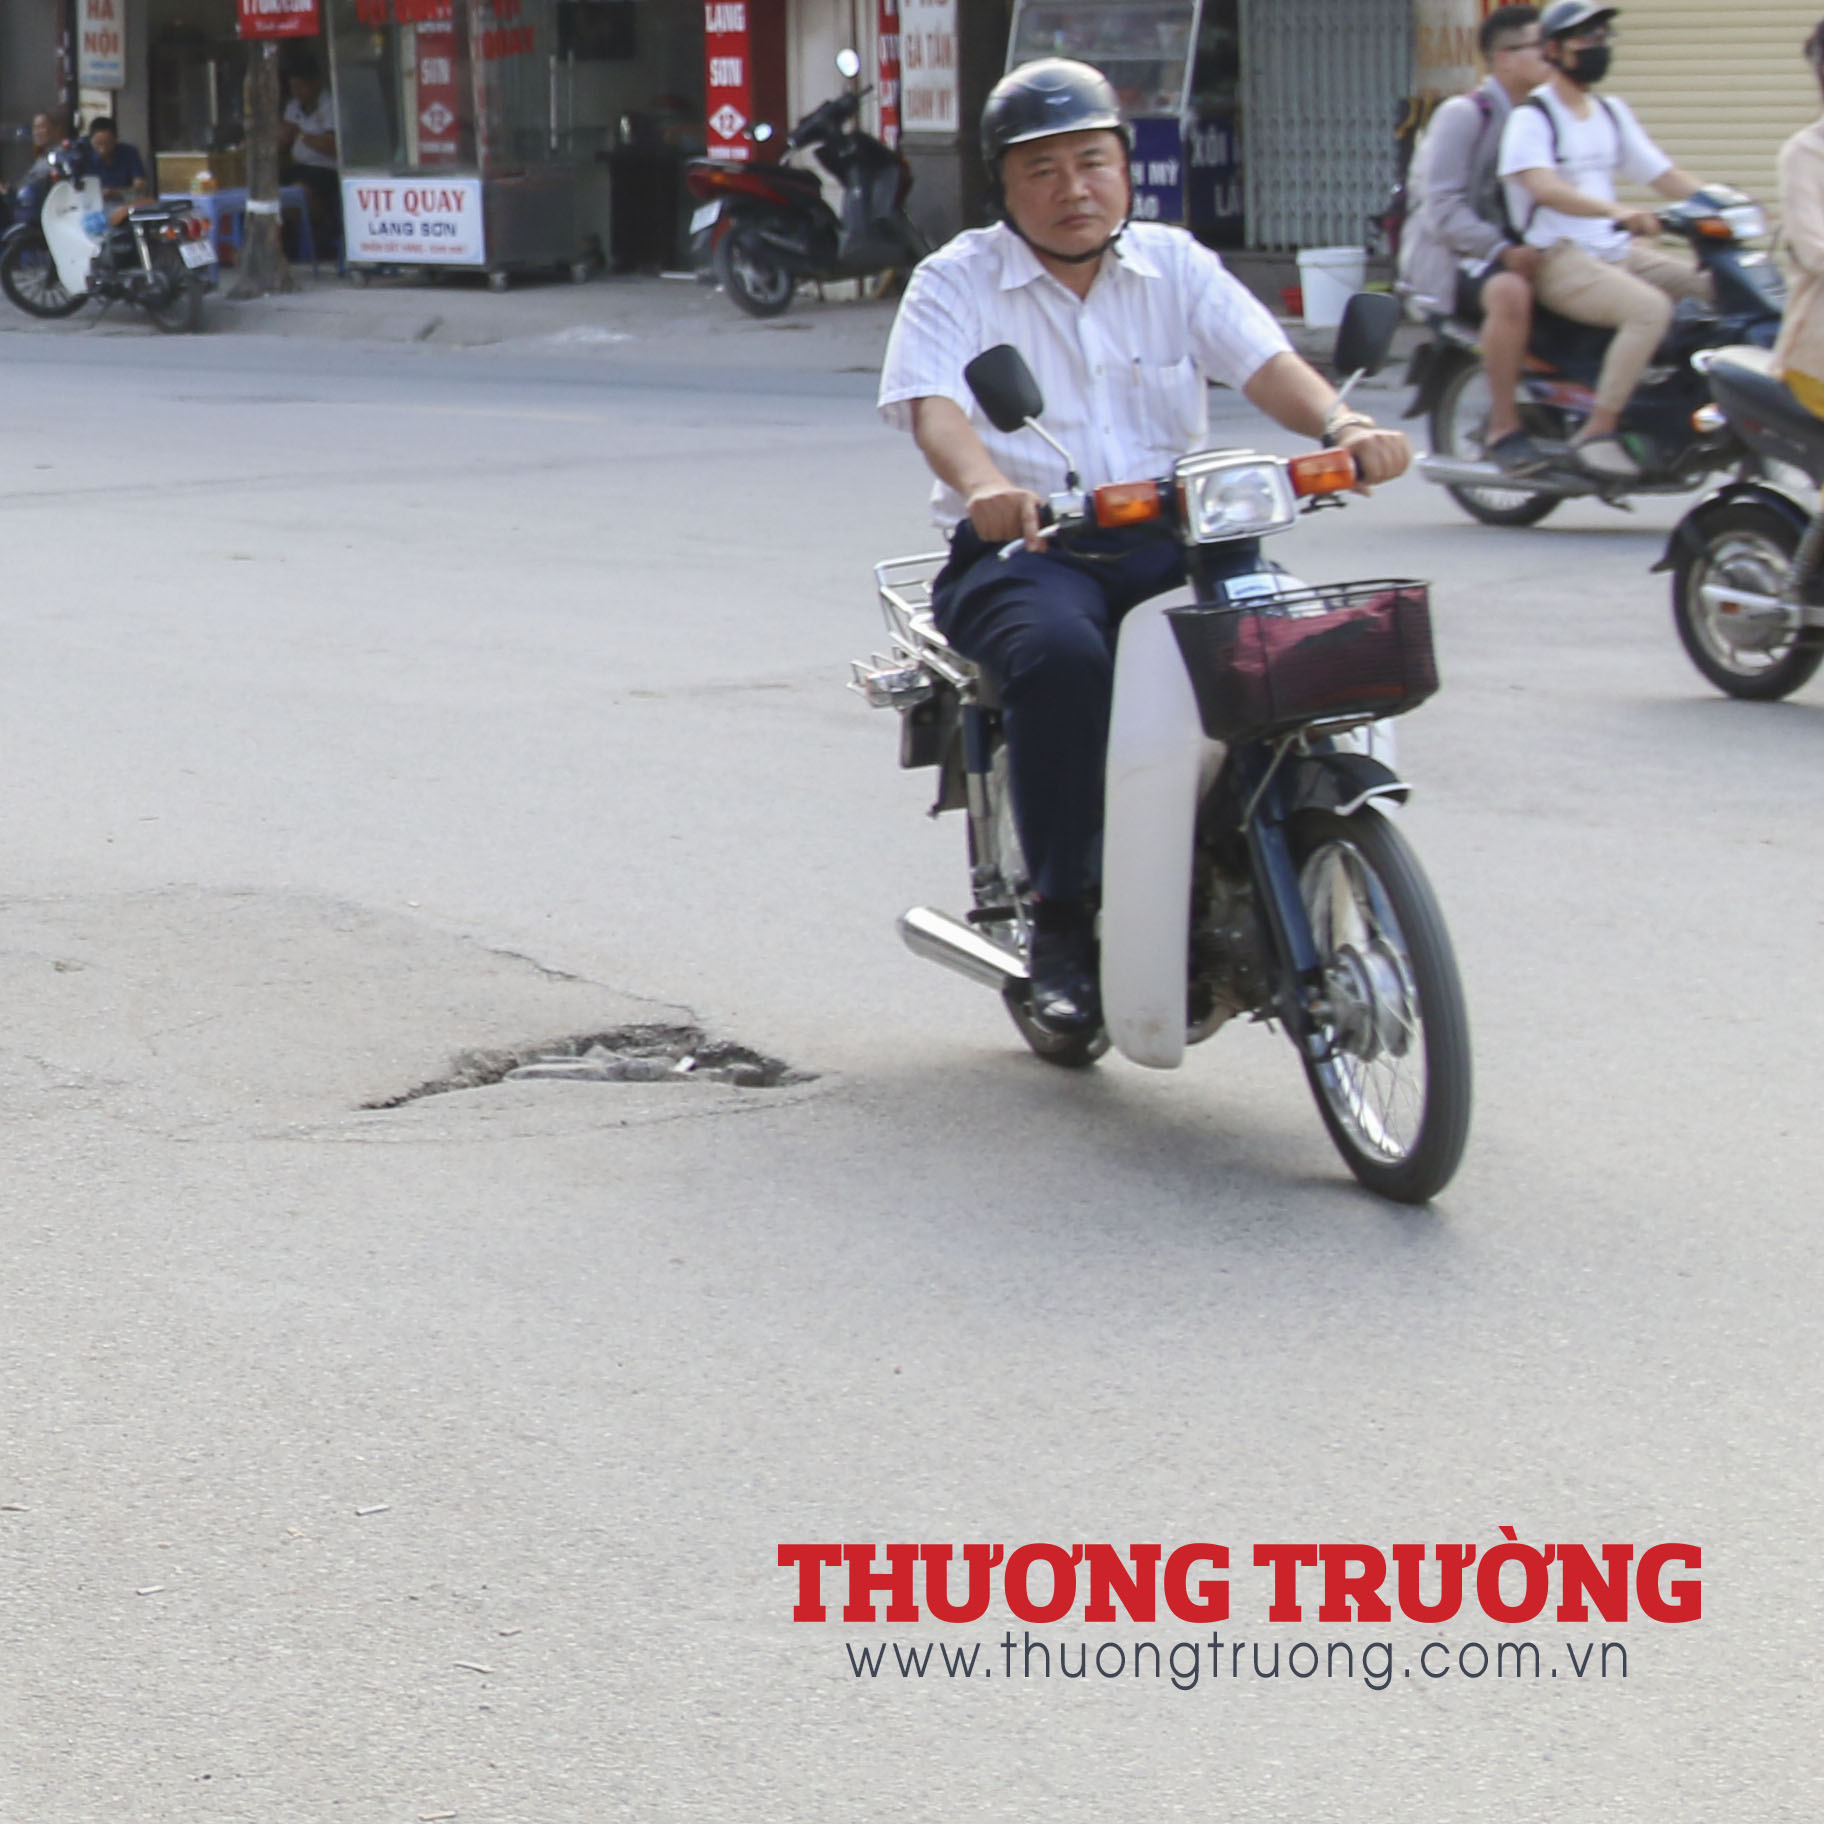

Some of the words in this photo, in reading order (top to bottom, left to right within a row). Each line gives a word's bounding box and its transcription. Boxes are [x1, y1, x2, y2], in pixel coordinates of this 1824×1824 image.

[705, 2, 745, 37] LẠNG
[358, 189, 394, 217] VỊT
[404, 189, 465, 217] QUAY
